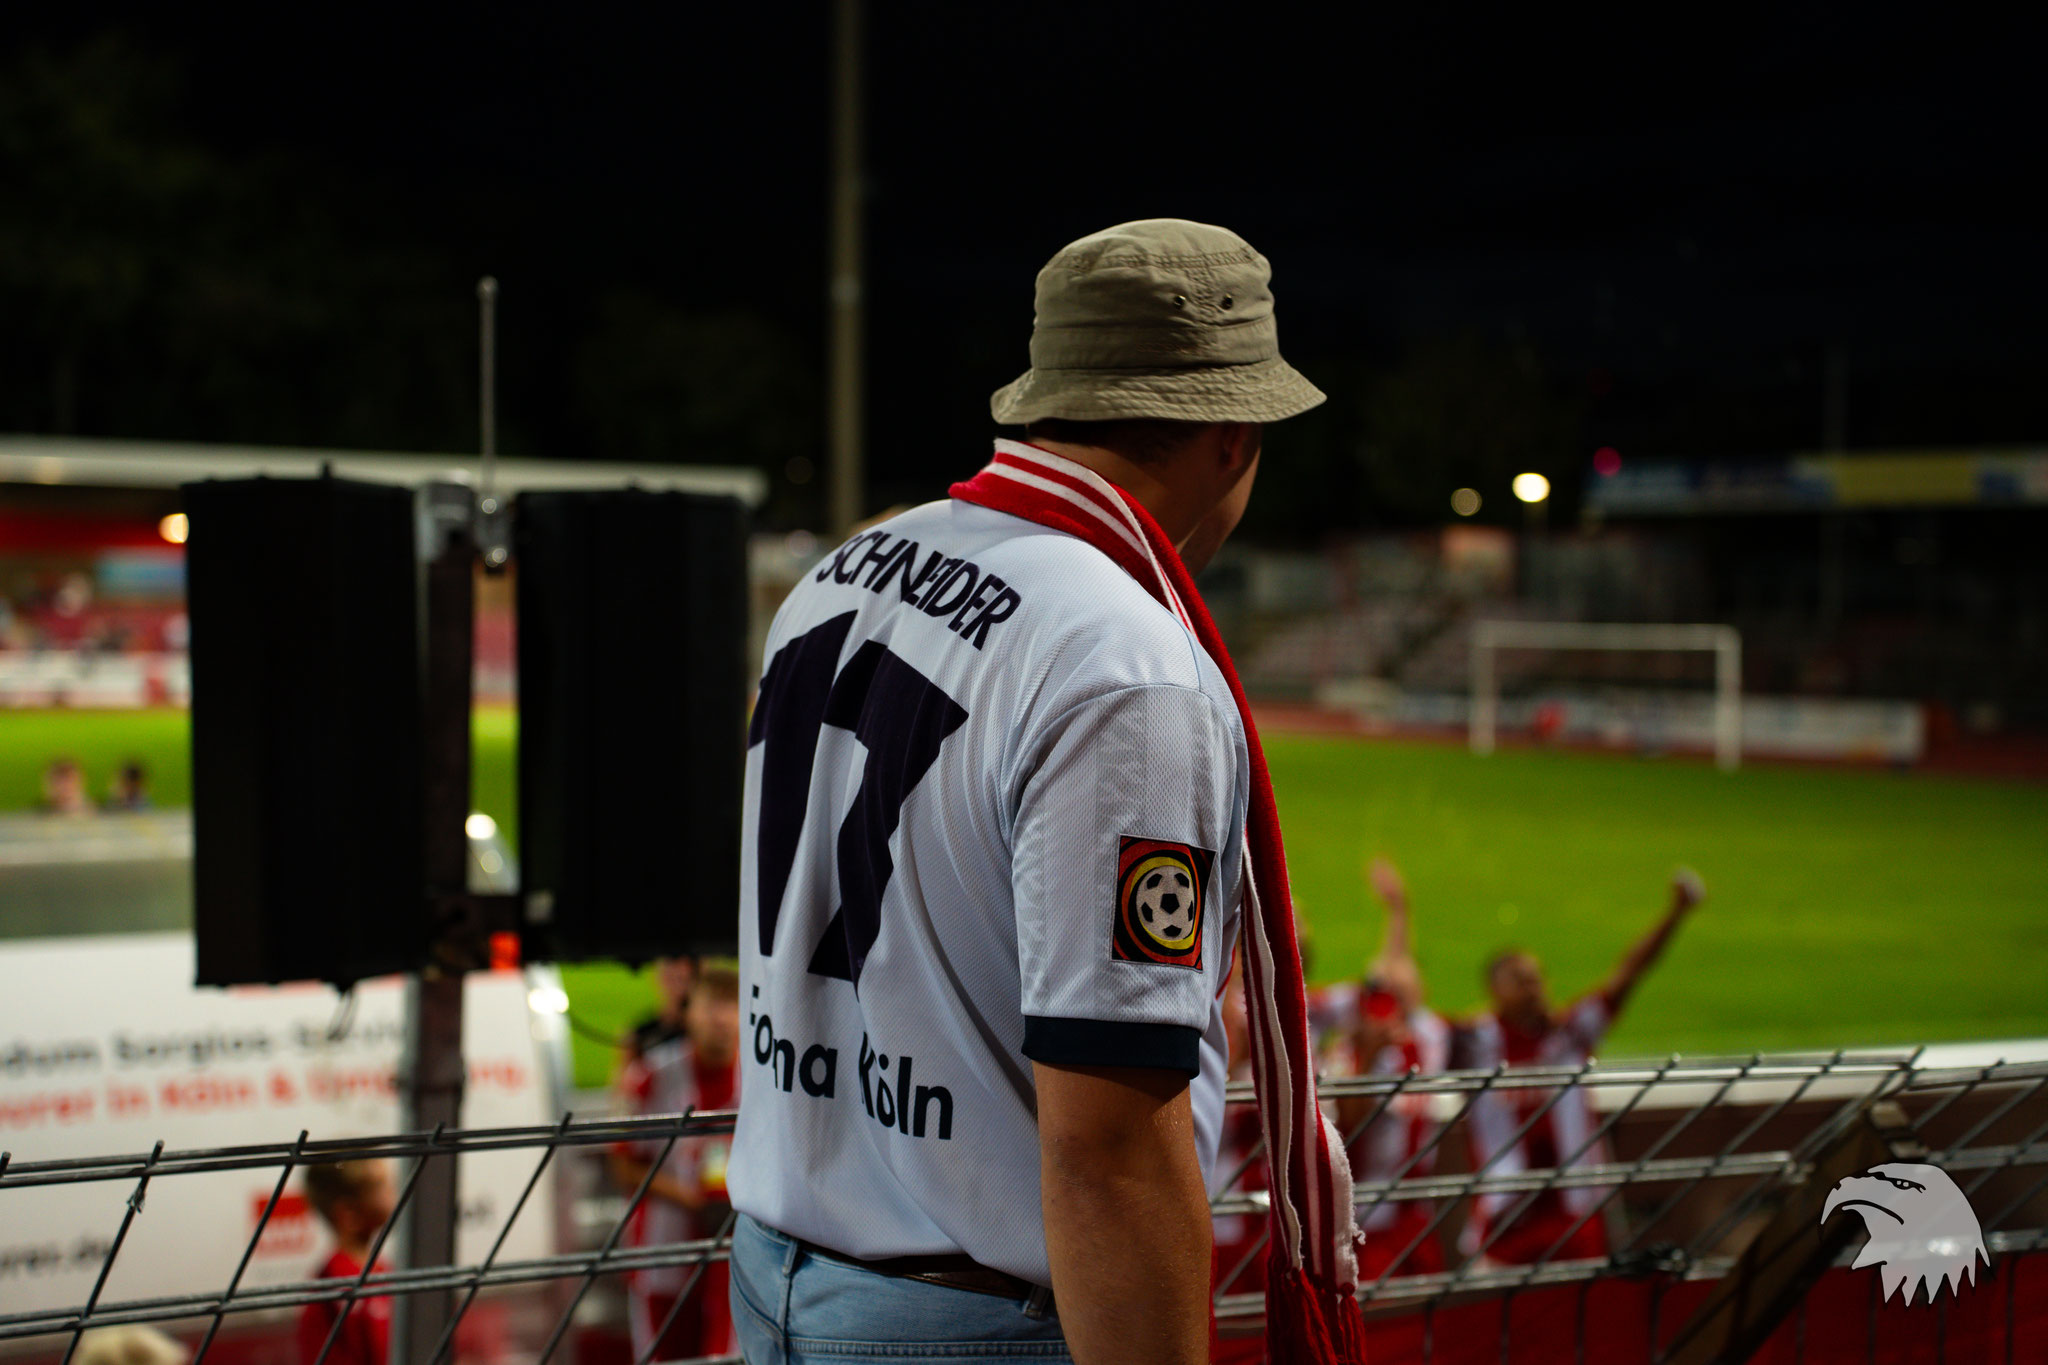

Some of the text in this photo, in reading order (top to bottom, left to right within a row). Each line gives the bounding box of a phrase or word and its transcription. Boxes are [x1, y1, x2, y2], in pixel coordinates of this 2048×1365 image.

[816, 530, 1022, 651] SCHNEIDER
[747, 609, 969, 1003] 17
[858, 1031, 954, 1140] Köln
